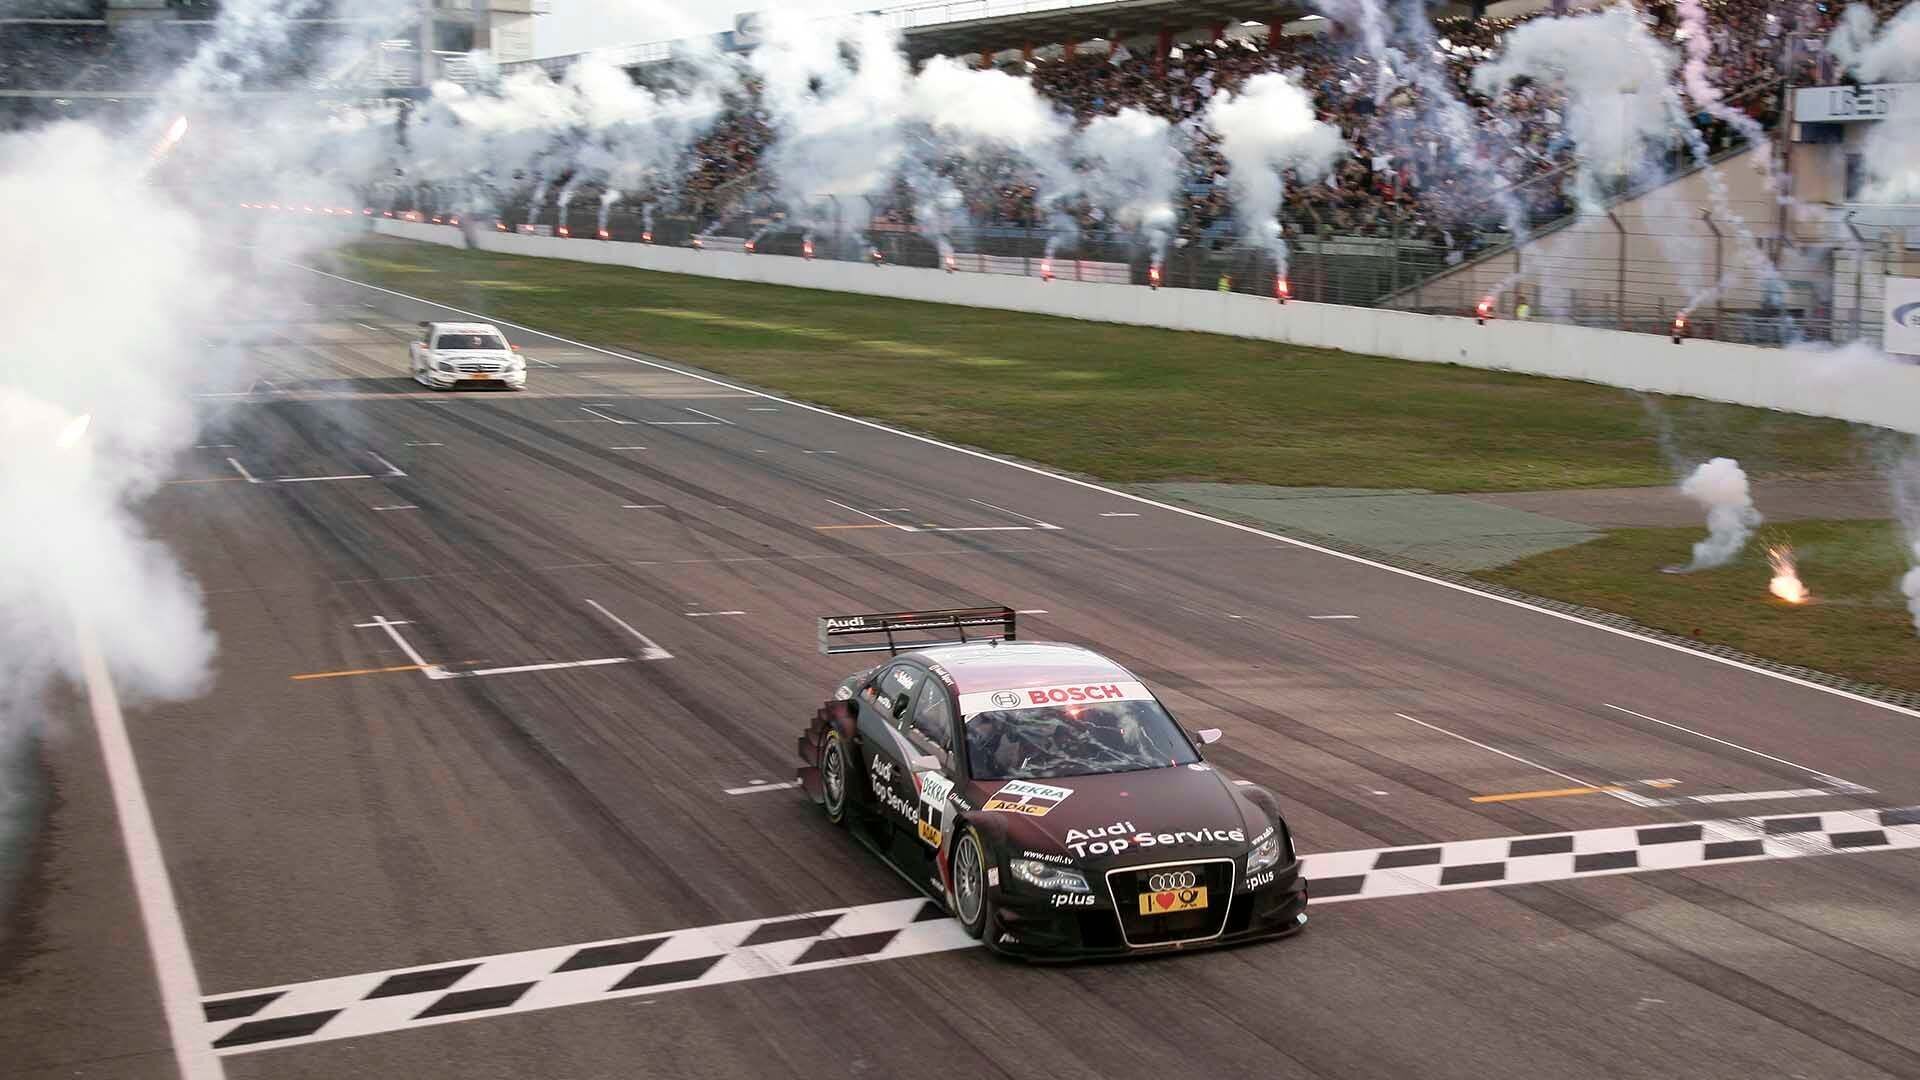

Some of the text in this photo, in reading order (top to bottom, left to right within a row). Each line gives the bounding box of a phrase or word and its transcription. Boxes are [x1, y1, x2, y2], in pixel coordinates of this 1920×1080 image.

[827, 617, 865, 628] Audi
[1028, 685, 1124, 704] BOSCH
[872, 754, 893, 781] Audi
[871, 774, 918, 824] Top Service
[923, 777, 947, 808] DEKRA
[1004, 783, 1064, 799] DEKRA
[927, 804, 933, 826] 1
[993, 801, 1038, 813] ADAC
[1065, 821, 1137, 844] Audi
[1068, 827, 1246, 858] Top Service
[1023, 850, 1074, 865] www.audi.tv
[1246, 871, 1274, 891] :plus
[1050, 892, 1096, 907] :plus
